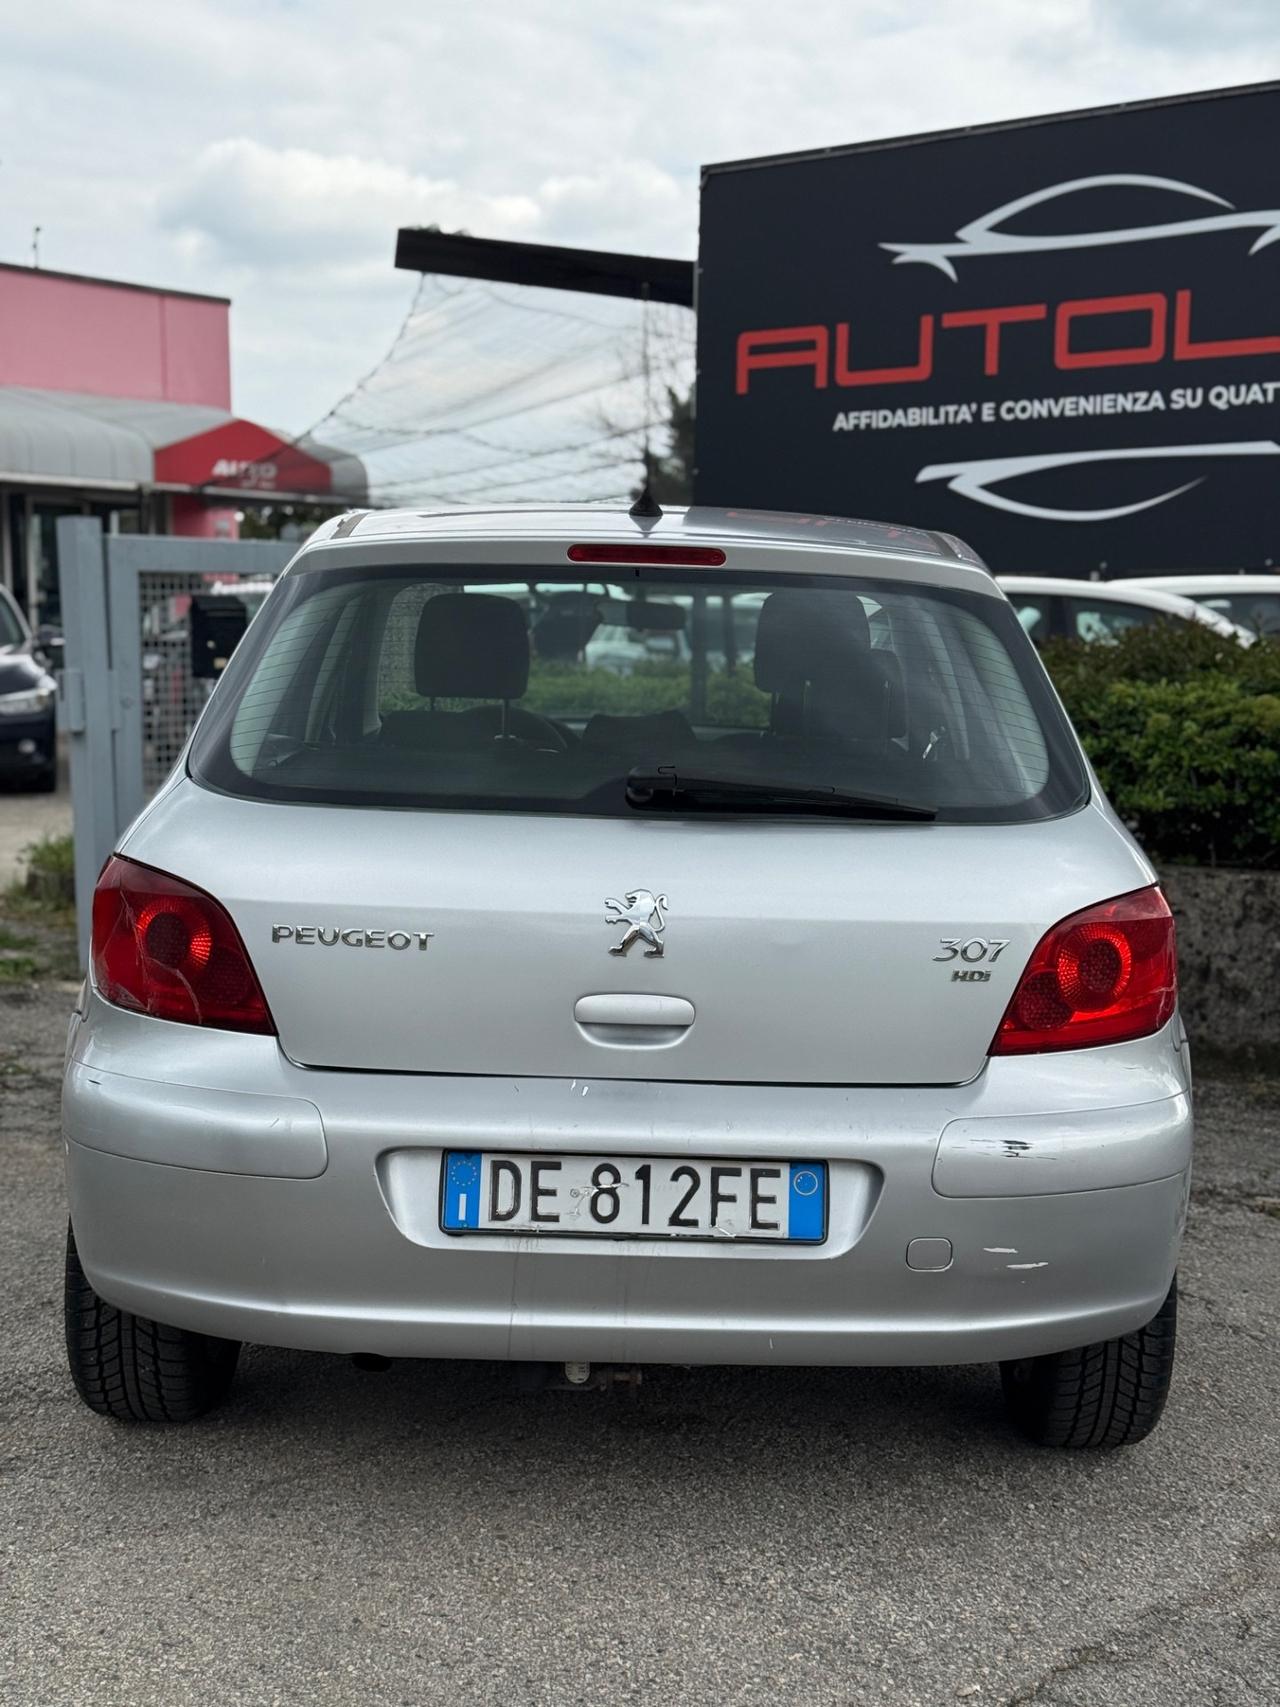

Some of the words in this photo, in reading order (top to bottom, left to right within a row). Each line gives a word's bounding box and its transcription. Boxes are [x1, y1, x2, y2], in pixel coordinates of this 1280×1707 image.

[832, 403, 977, 432] AFFIDABILITA'
[981, 402, 996, 422] E
[1000, 391, 1166, 420] CONVENIENZA
[1170, 387, 1204, 411] SU
[1208, 381, 1280, 411] QUAT
[271, 923, 435, 951] PEUGEOT
[932, 937, 1011, 962] 307
[489, 1159, 562, 1222] DE
